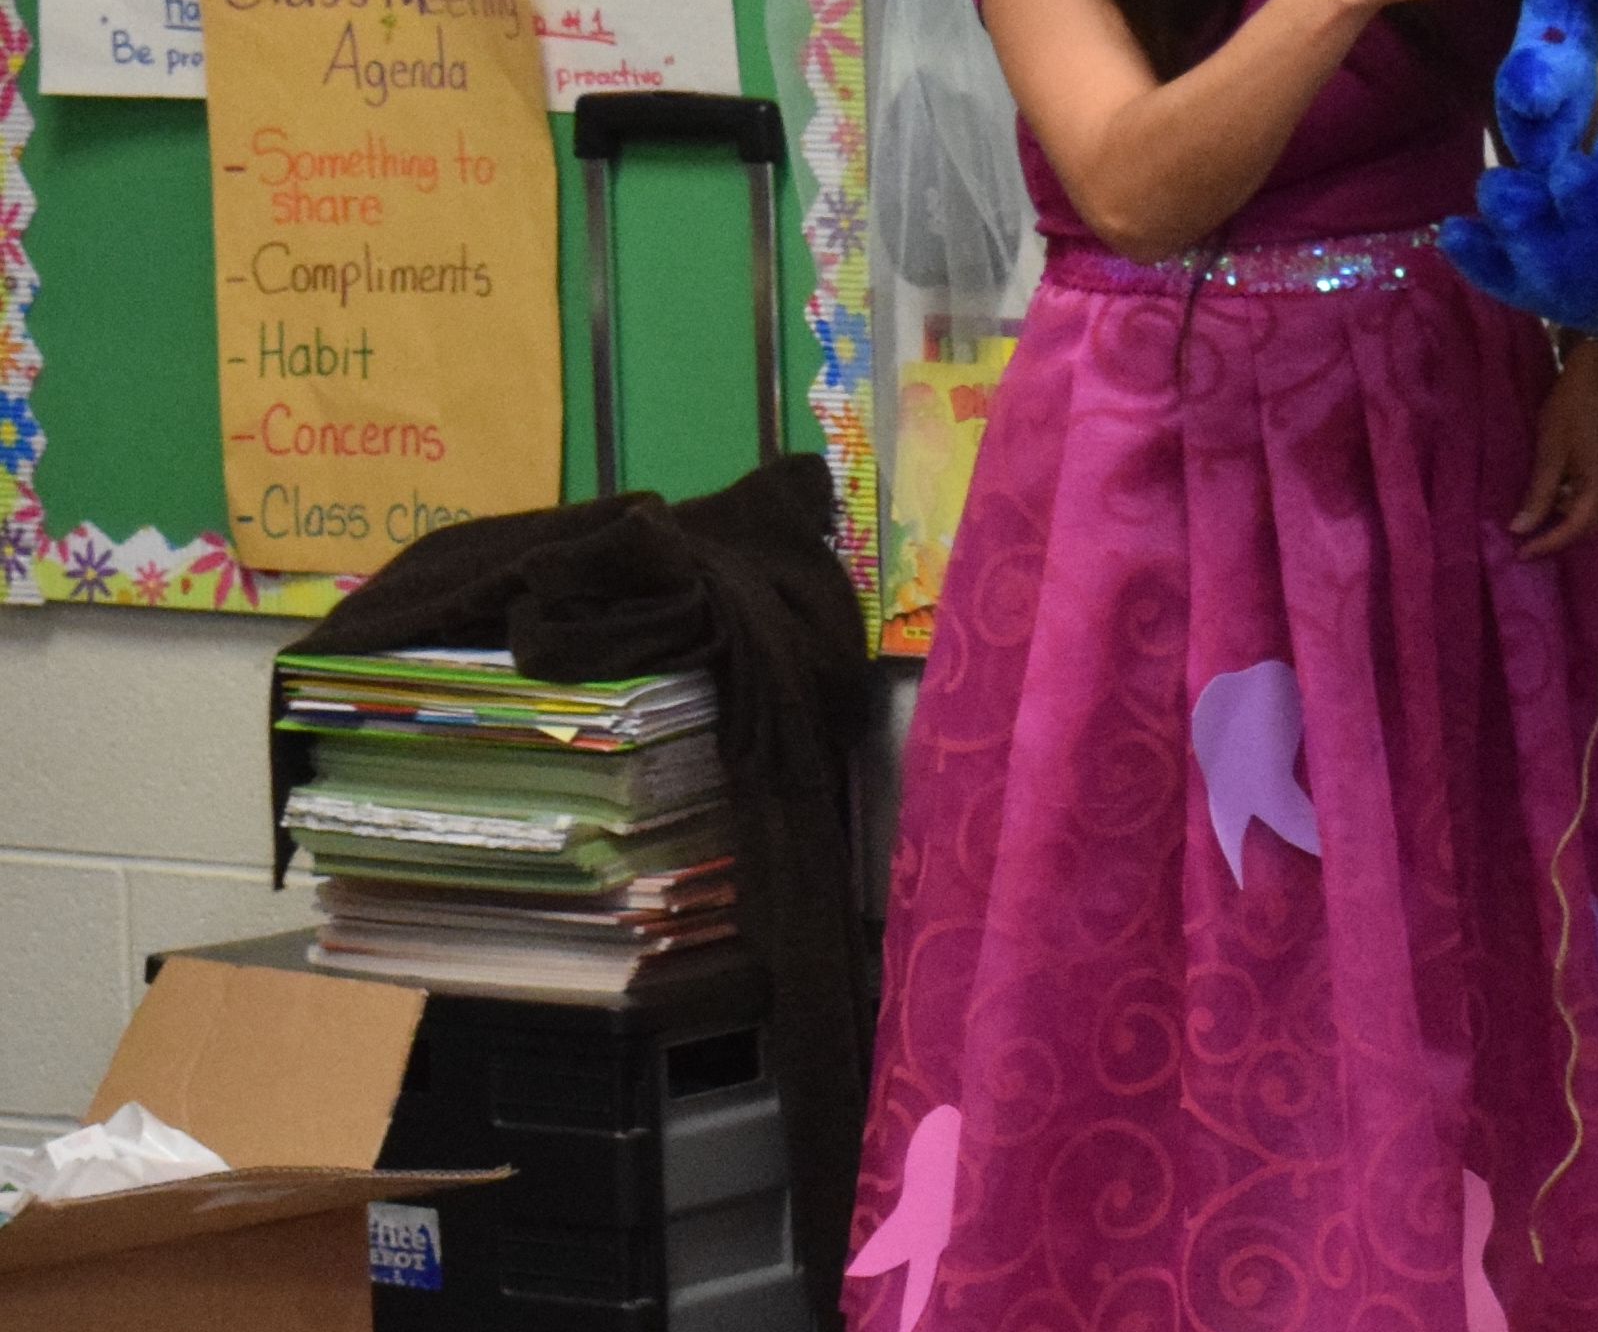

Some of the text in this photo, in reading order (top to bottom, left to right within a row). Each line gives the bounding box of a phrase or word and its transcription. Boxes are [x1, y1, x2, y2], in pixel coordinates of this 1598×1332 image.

[111, 29, 154, 65] Be
[323, 20, 468, 108] Agenda
[251, 126, 495, 194] Something to
[271, 181, 383, 225] share
